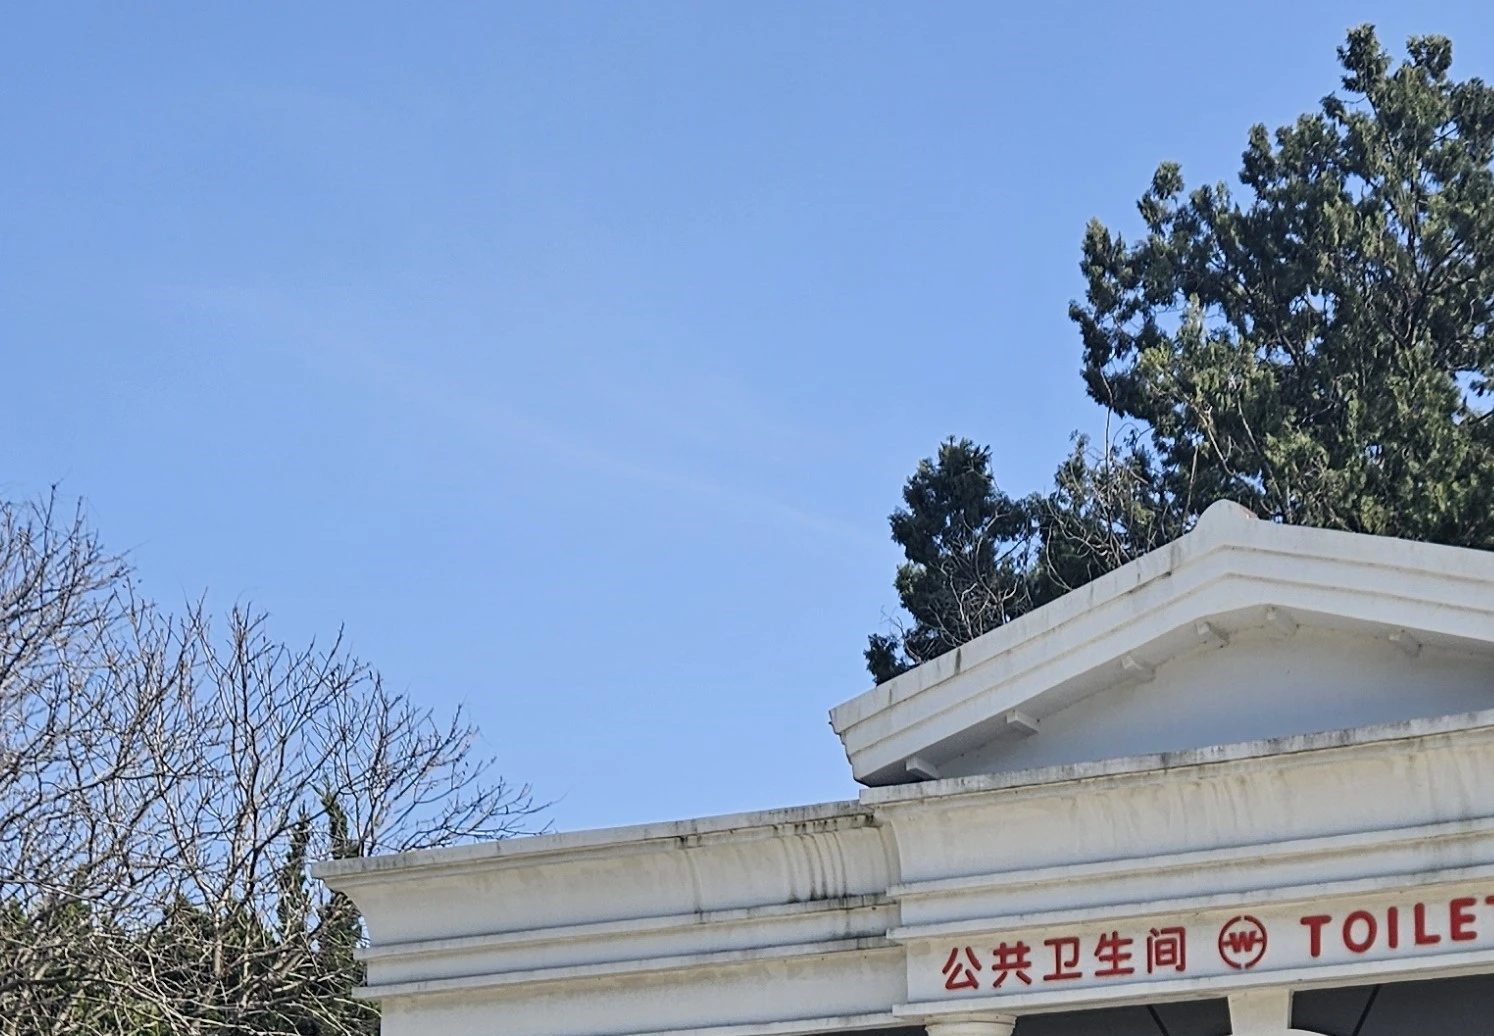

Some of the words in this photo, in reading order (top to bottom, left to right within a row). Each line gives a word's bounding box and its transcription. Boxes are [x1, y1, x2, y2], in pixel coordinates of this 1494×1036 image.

[942, 926, 1186, 990] 公共卫生间
